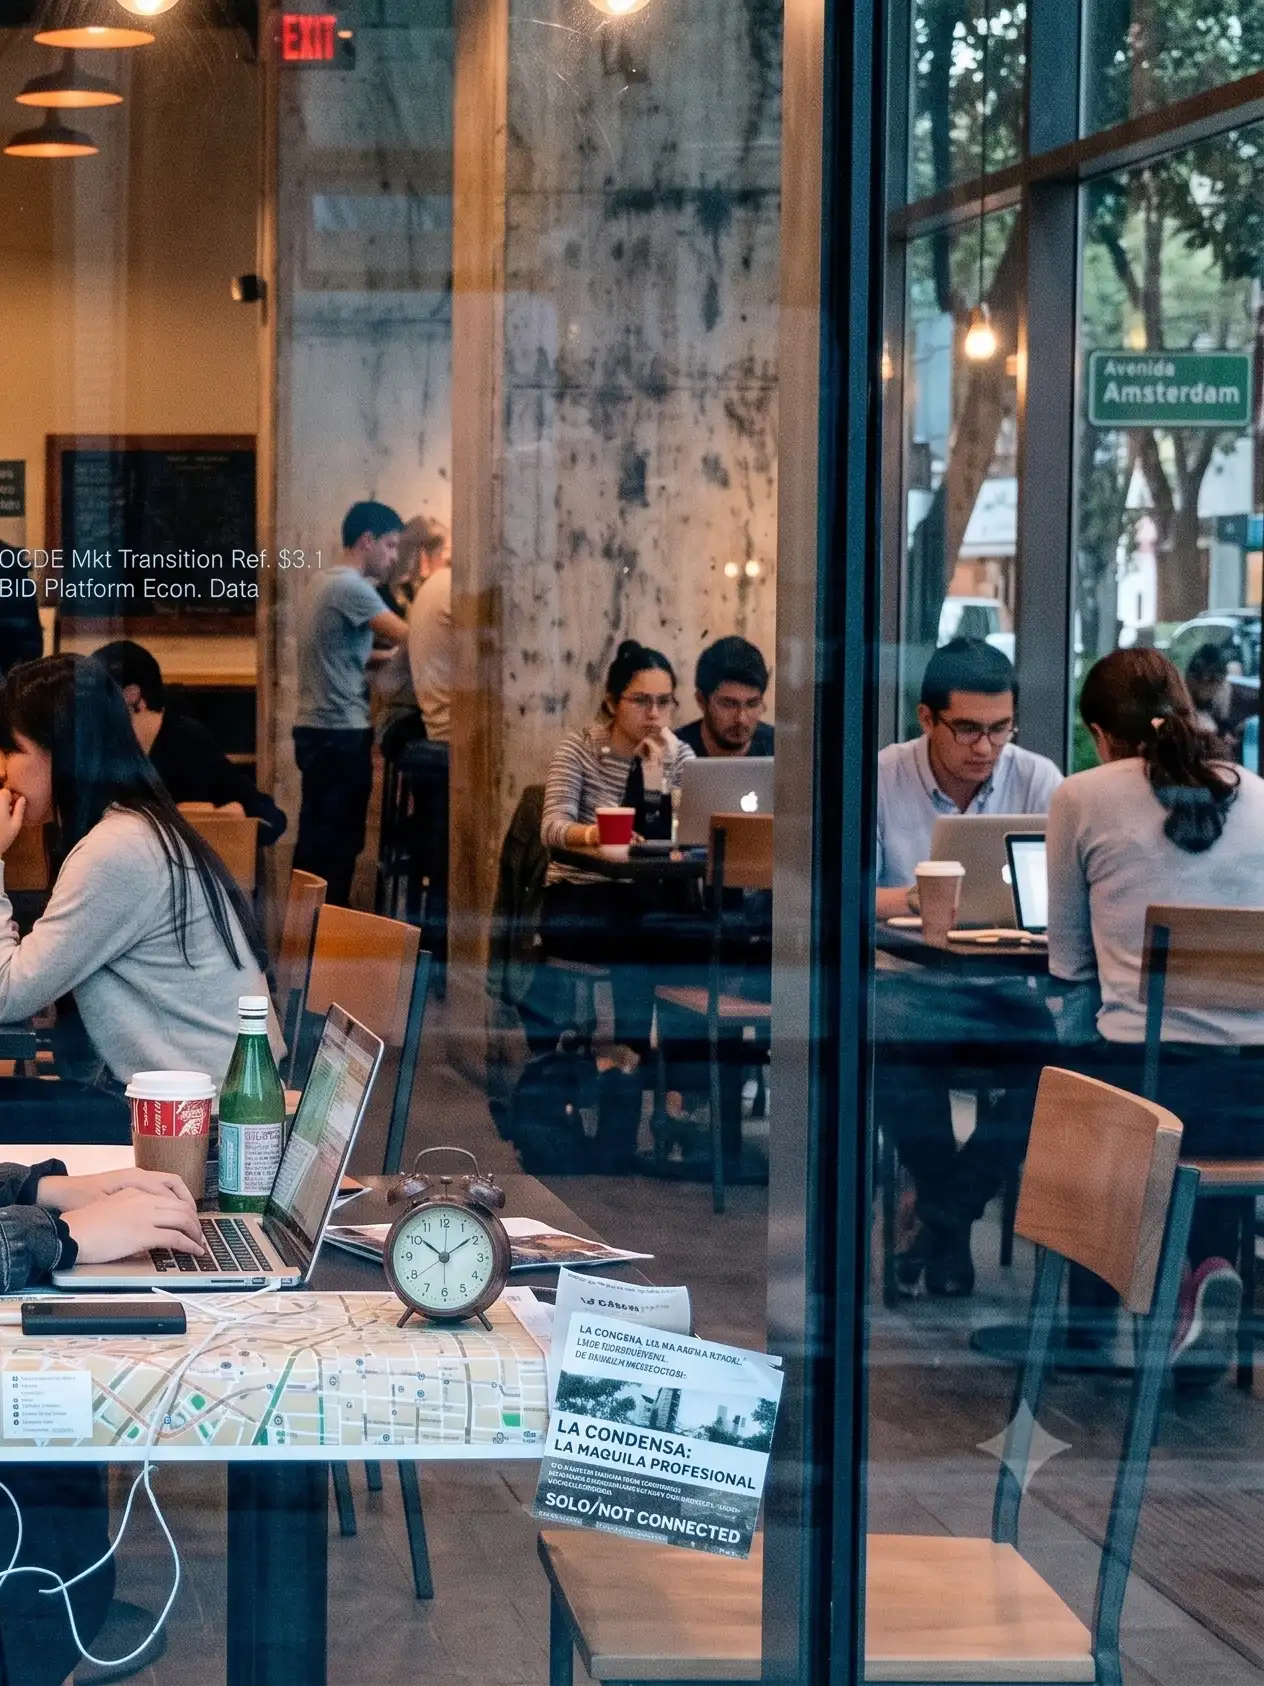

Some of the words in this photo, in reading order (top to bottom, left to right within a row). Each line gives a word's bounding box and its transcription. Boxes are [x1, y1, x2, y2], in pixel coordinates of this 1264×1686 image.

[282, 14, 336, 60] EXIT
[1103, 359, 1176, 377] Avenida
[1103, 381, 1240, 404] Amsterdam
[423, 1222, 431, 1233] 11
[439, 1218, 450, 1228] 12
[461, 1222, 465, 1233] 1
[410, 1235, 423, 1245] 10
[471, 1235, 479, 1245] 2
[405, 1252, 413, 1261] 9
[476, 1252, 484, 1262] 3
[410, 1269, 418, 1280] 8
[471, 1270, 479, 1280] 4
[423, 1283, 431, 1292] 7
[441, 1287, 449, 1297] 6
[459, 1283, 467, 1293] 5
[557, 1419, 580, 1436] LA
[585, 1424, 692, 1459] CONDENSA:
[554, 1439, 573, 1453] LA
[577, 1443, 647, 1468] MAQUILA
[650, 1458, 756, 1490] PROFESIONAL
[545, 1492, 634, 1522] SOLO/NOT
[637, 1511, 741, 1544] CONNECTED
